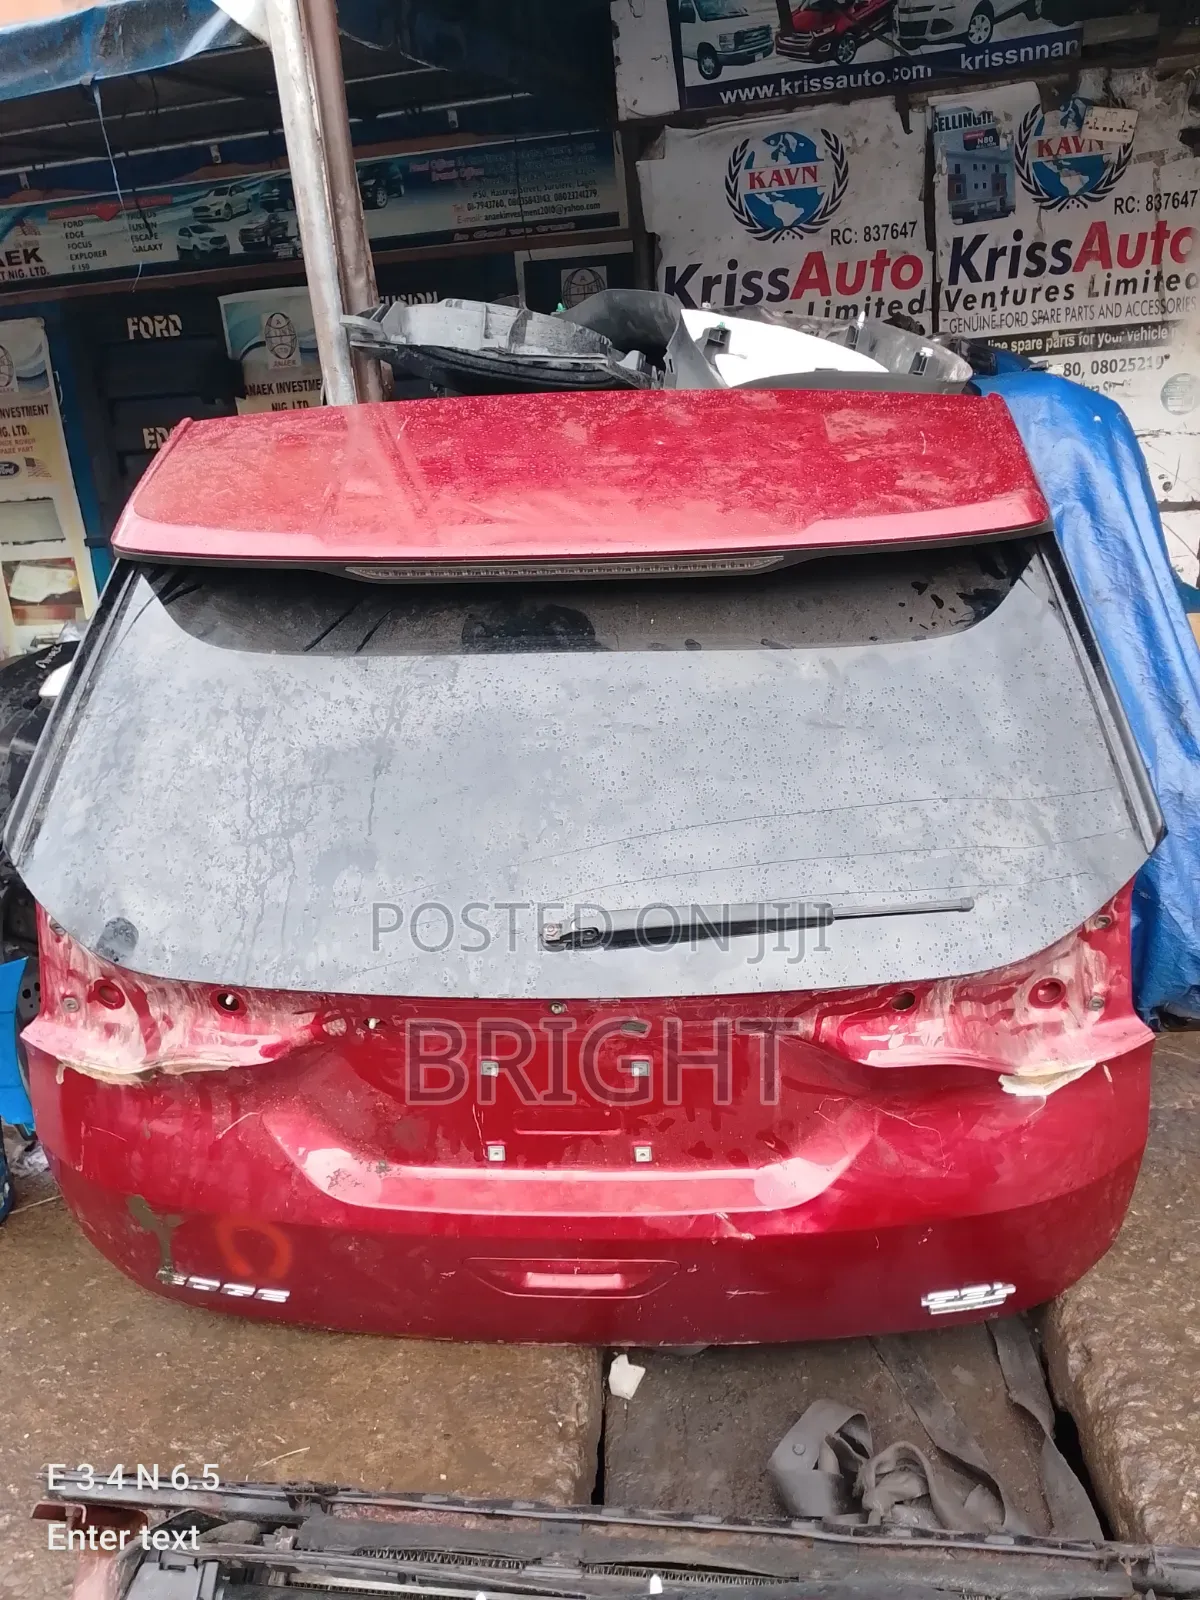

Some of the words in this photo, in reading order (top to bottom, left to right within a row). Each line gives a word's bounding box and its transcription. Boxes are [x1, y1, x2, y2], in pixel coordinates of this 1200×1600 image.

[719, 66, 932, 104] www.krissauto.com
[748, 165, 818, 190] KAVN
[1114, 195, 1140, 215] RC:
[1145, 190, 1199, 212] 837647
[63, 219, 84, 229] FORD
[65, 231, 85, 240] EDGE
[830, 227, 858, 246] RC:
[863, 220, 918, 243] 837647
[67, 241, 93, 250] FOCUS
[69, 250, 108, 261] EXPLORER
[132, 243, 163, 253] GALAXY
[948, 219, 1199, 286] KrissAuto
[29, 266, 50, 277] LTD.
[665, 249, 924, 309] KrissAuto
[945, 281, 1075, 312] Ventures
[127, 314, 183, 340] FORD
[950, 312, 997, 335] GENUINE
[1000, 312, 1029, 332] FORD
[1031, 309, 1062, 326] SPARE
[1064, 306, 1095, 322] PARTS
[1098, 305, 1121, 319] AND
[1125, 296, 1198, 318] ACCESSORIES
[1011, 338, 1042, 354] spare
[1046, 334, 1075, 352] parts
[1078, 333, 1096, 346] for
[1098, 330, 1123, 348] your
[1126, 325, 1168, 342] vehicle
[276, 378, 322, 394] INVESTME
[12, 424, 30, 437] LTD.
